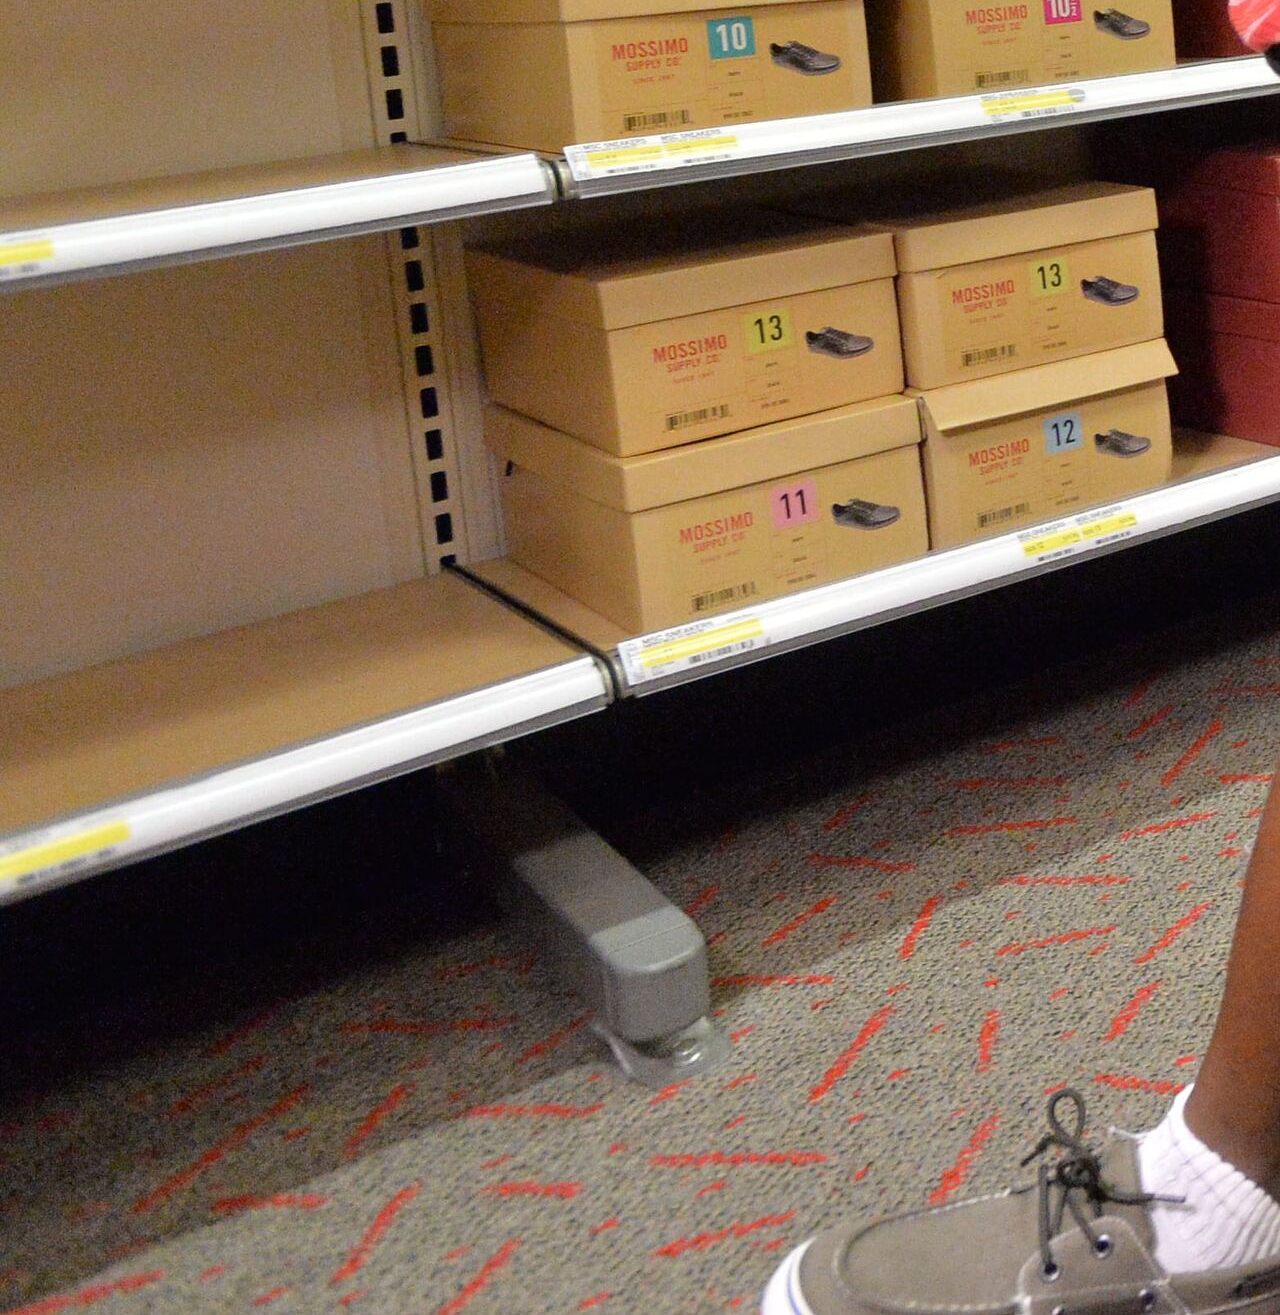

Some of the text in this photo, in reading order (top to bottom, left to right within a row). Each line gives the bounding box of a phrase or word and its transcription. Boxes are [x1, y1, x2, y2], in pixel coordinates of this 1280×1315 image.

[966, 5, 1028, 25] MOSSIMO
[612, 37, 688, 61] MOSSIMO
[716, 22, 748, 52] 10
[1037, 264, 1062, 289] 13
[952, 280, 1015, 304] MOSSIMO
[754, 315, 783, 344] 13
[653, 334, 728, 363] MOSSIMO
[1052, 420, 1076, 446] 12
[969, 439, 1029, 467] MOSSIMO
[779, 489, 808, 519] 11
[680, 512, 753, 544] MOSSIMO
